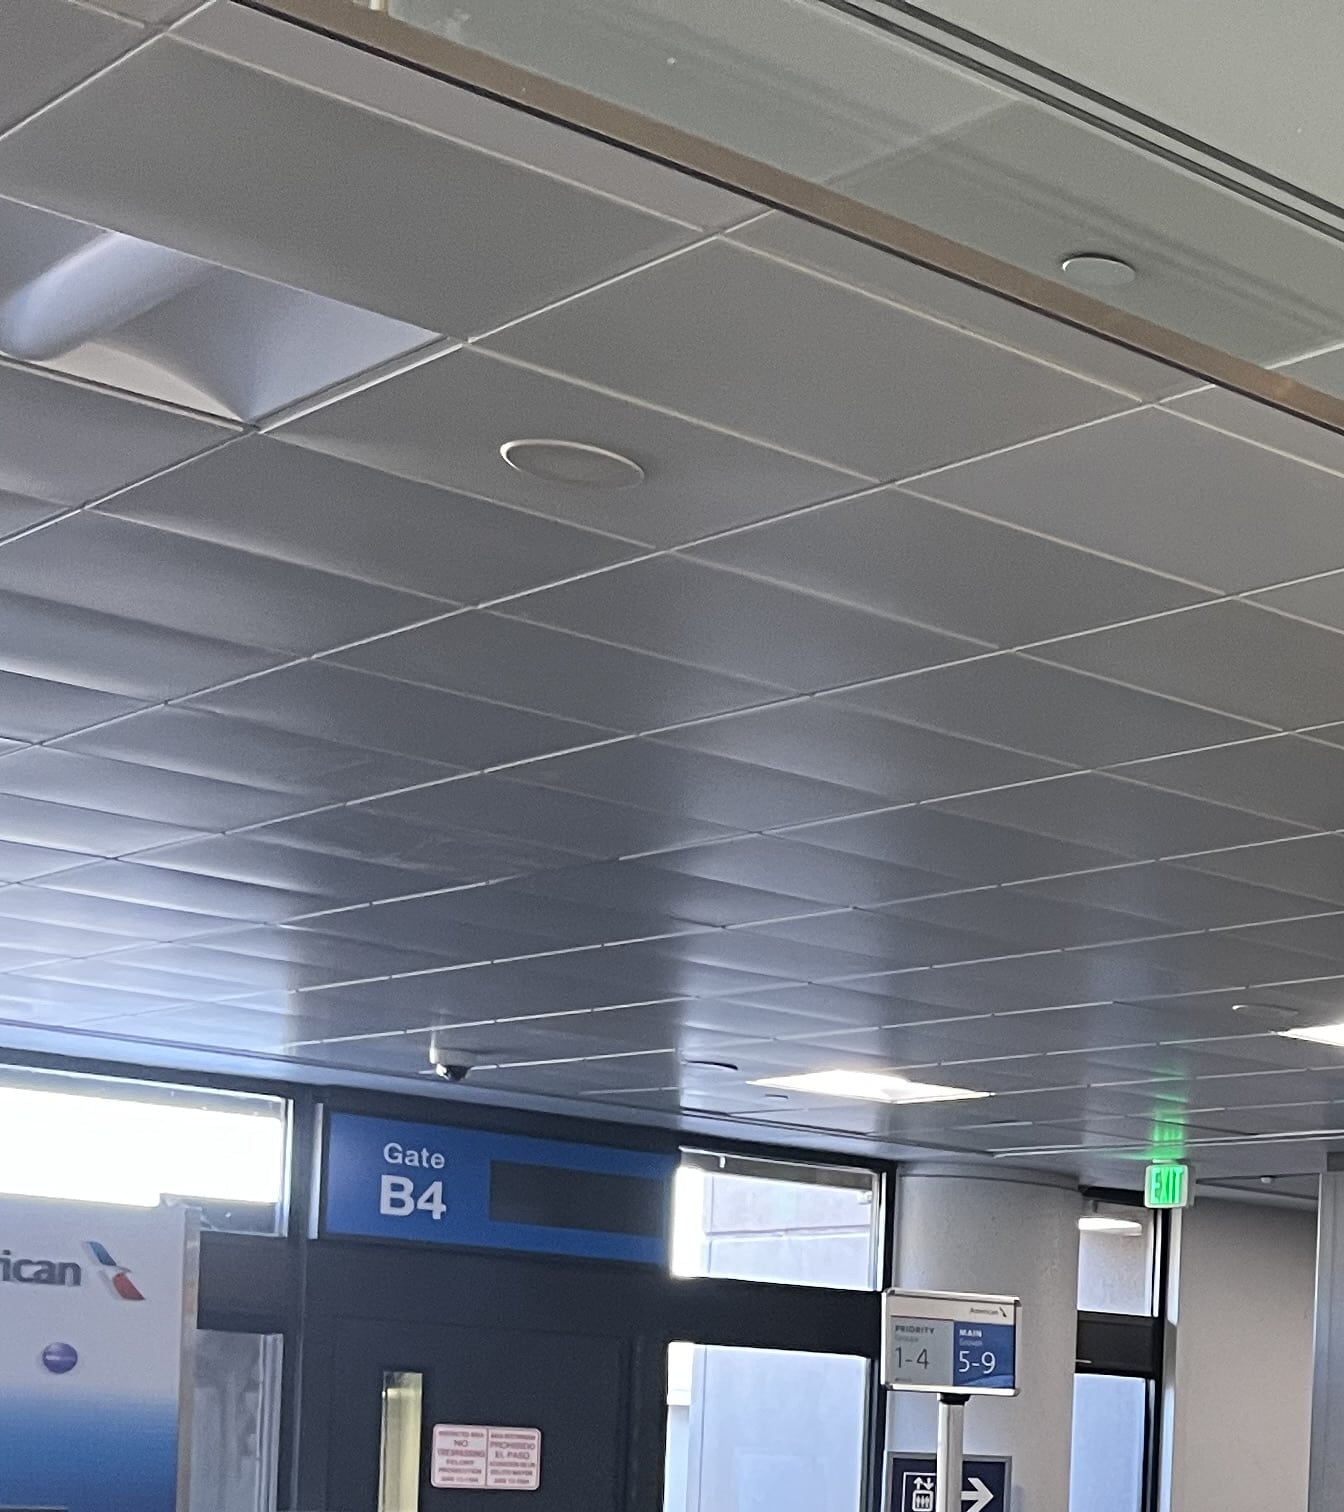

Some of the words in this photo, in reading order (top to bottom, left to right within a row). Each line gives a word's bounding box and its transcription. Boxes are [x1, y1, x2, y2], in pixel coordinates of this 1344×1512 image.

[383, 1142, 445, 1169] Gate
[379, 1174, 447, 1220] B4
[1150, 1167, 1184, 1204] EXIT
[0, 1249, 81, 1286] ican
[895, 1325, 934, 1334] PRIORITY
[959, 1350, 996, 1374] 5-9
